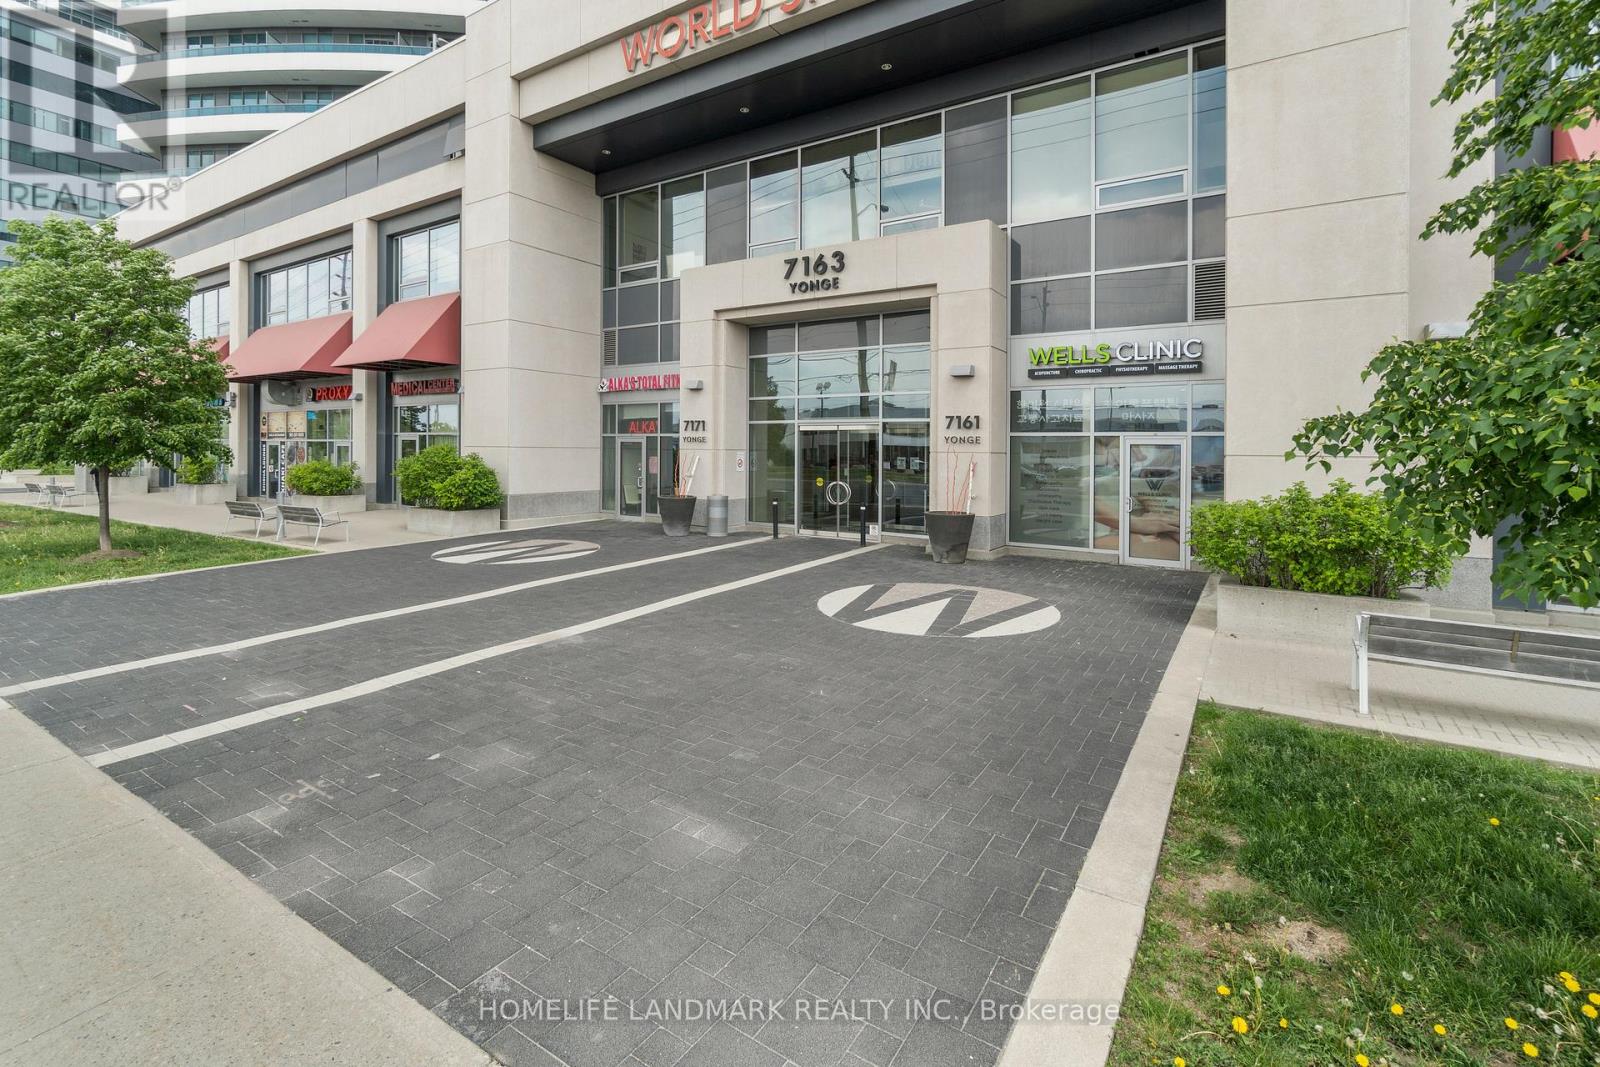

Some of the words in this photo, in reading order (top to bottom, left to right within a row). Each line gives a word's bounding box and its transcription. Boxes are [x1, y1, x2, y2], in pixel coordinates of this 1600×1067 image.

[620, 0, 764, 73] WORLD
[784, 251, 845, 280] 7163
[789, 277, 839, 294] YONGE
[1028, 343, 1112, 366] WELLS
[1115, 338, 1204, 362] CLINIC
[391, 380, 428, 397] MEDICAL
[428, 377, 455, 390] CENTER
[609, 376, 636, 391] ALKA'S
[637, 375, 662, 390] TOTAL
[629, 420, 657, 433] ALKA
[683, 420, 706, 432] 7171
[945, 416, 980, 429] 7161
[944, 436, 981, 444] YONGE
